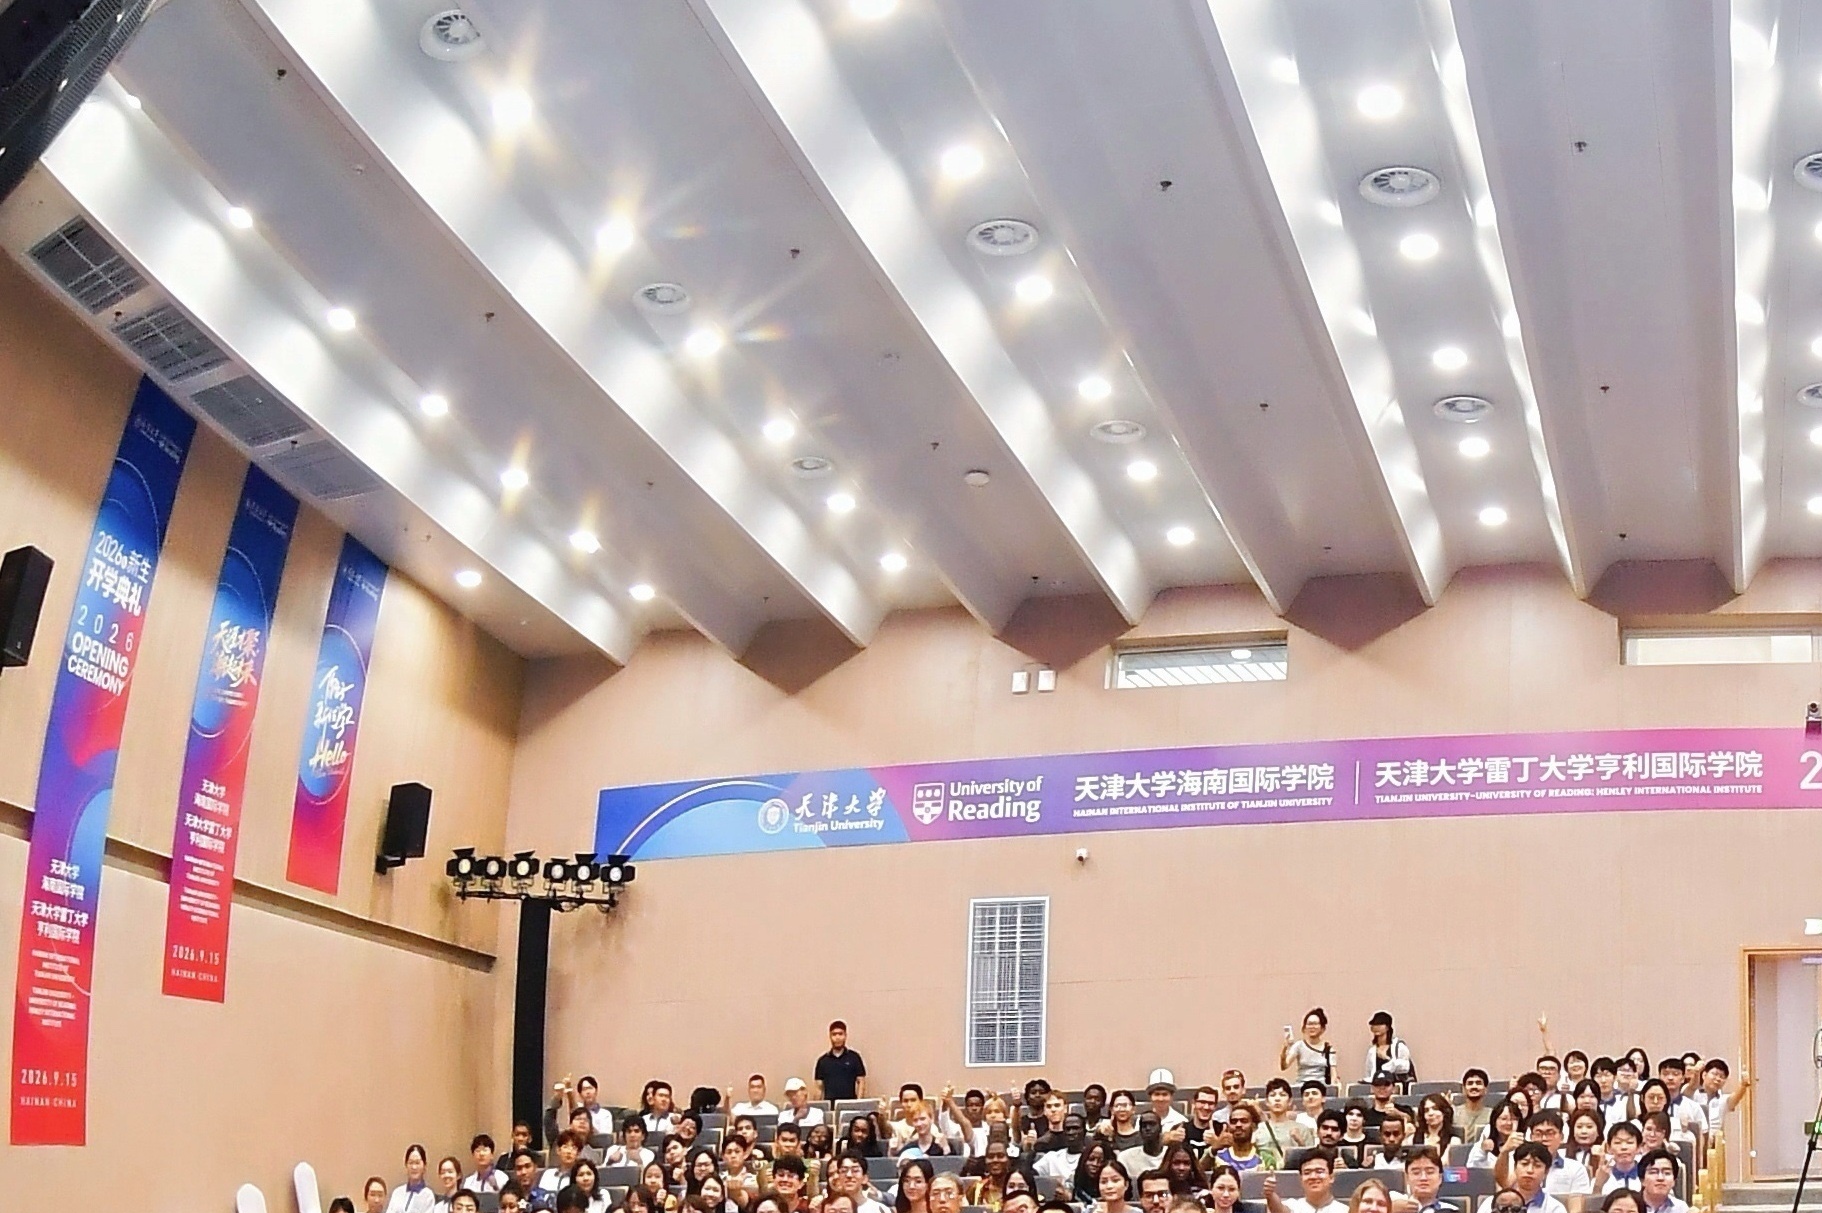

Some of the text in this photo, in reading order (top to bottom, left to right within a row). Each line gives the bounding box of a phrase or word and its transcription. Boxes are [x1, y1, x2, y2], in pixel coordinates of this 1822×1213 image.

[86, 557, 142, 616] 开学典礼
[72, 631, 130, 678] OPENING
[67, 656, 127, 696] CEREMONY
[309, 740, 352, 768] Hello
[1374, 750, 1764, 787] 天津大学雷丁大学亨利国际学院
[949, 775, 1044, 796] University of
[1074, 763, 1334, 802] 天津大学海南国际学院
[1375, 793, 1413, 804] TIANJIN
[1533, 789, 1547, 799] OF
[1596, 786, 1632, 796] HENLEY
[1634, 785, 1711, 795] INTERNATIONAL
[1713, 784, 1763, 794] INSTITUTE
[794, 787, 887, 821] 天津大学
[948, 796, 1042, 823] Reading
[1109, 805, 1180, 816] INTERNATIONAL
[1181, 802, 1226, 812] INSTITUTE
[1227, 801, 1240, 810] OF
[1241, 799, 1278, 809] TIANJIN
[1278, 797, 1333, 807] UNIVERSITY
[793, 818, 884, 834] Tianjin University
[173, 944, 220, 966] 2026.9.15
[21, 1068, 77, 1087] 2026.9.15
